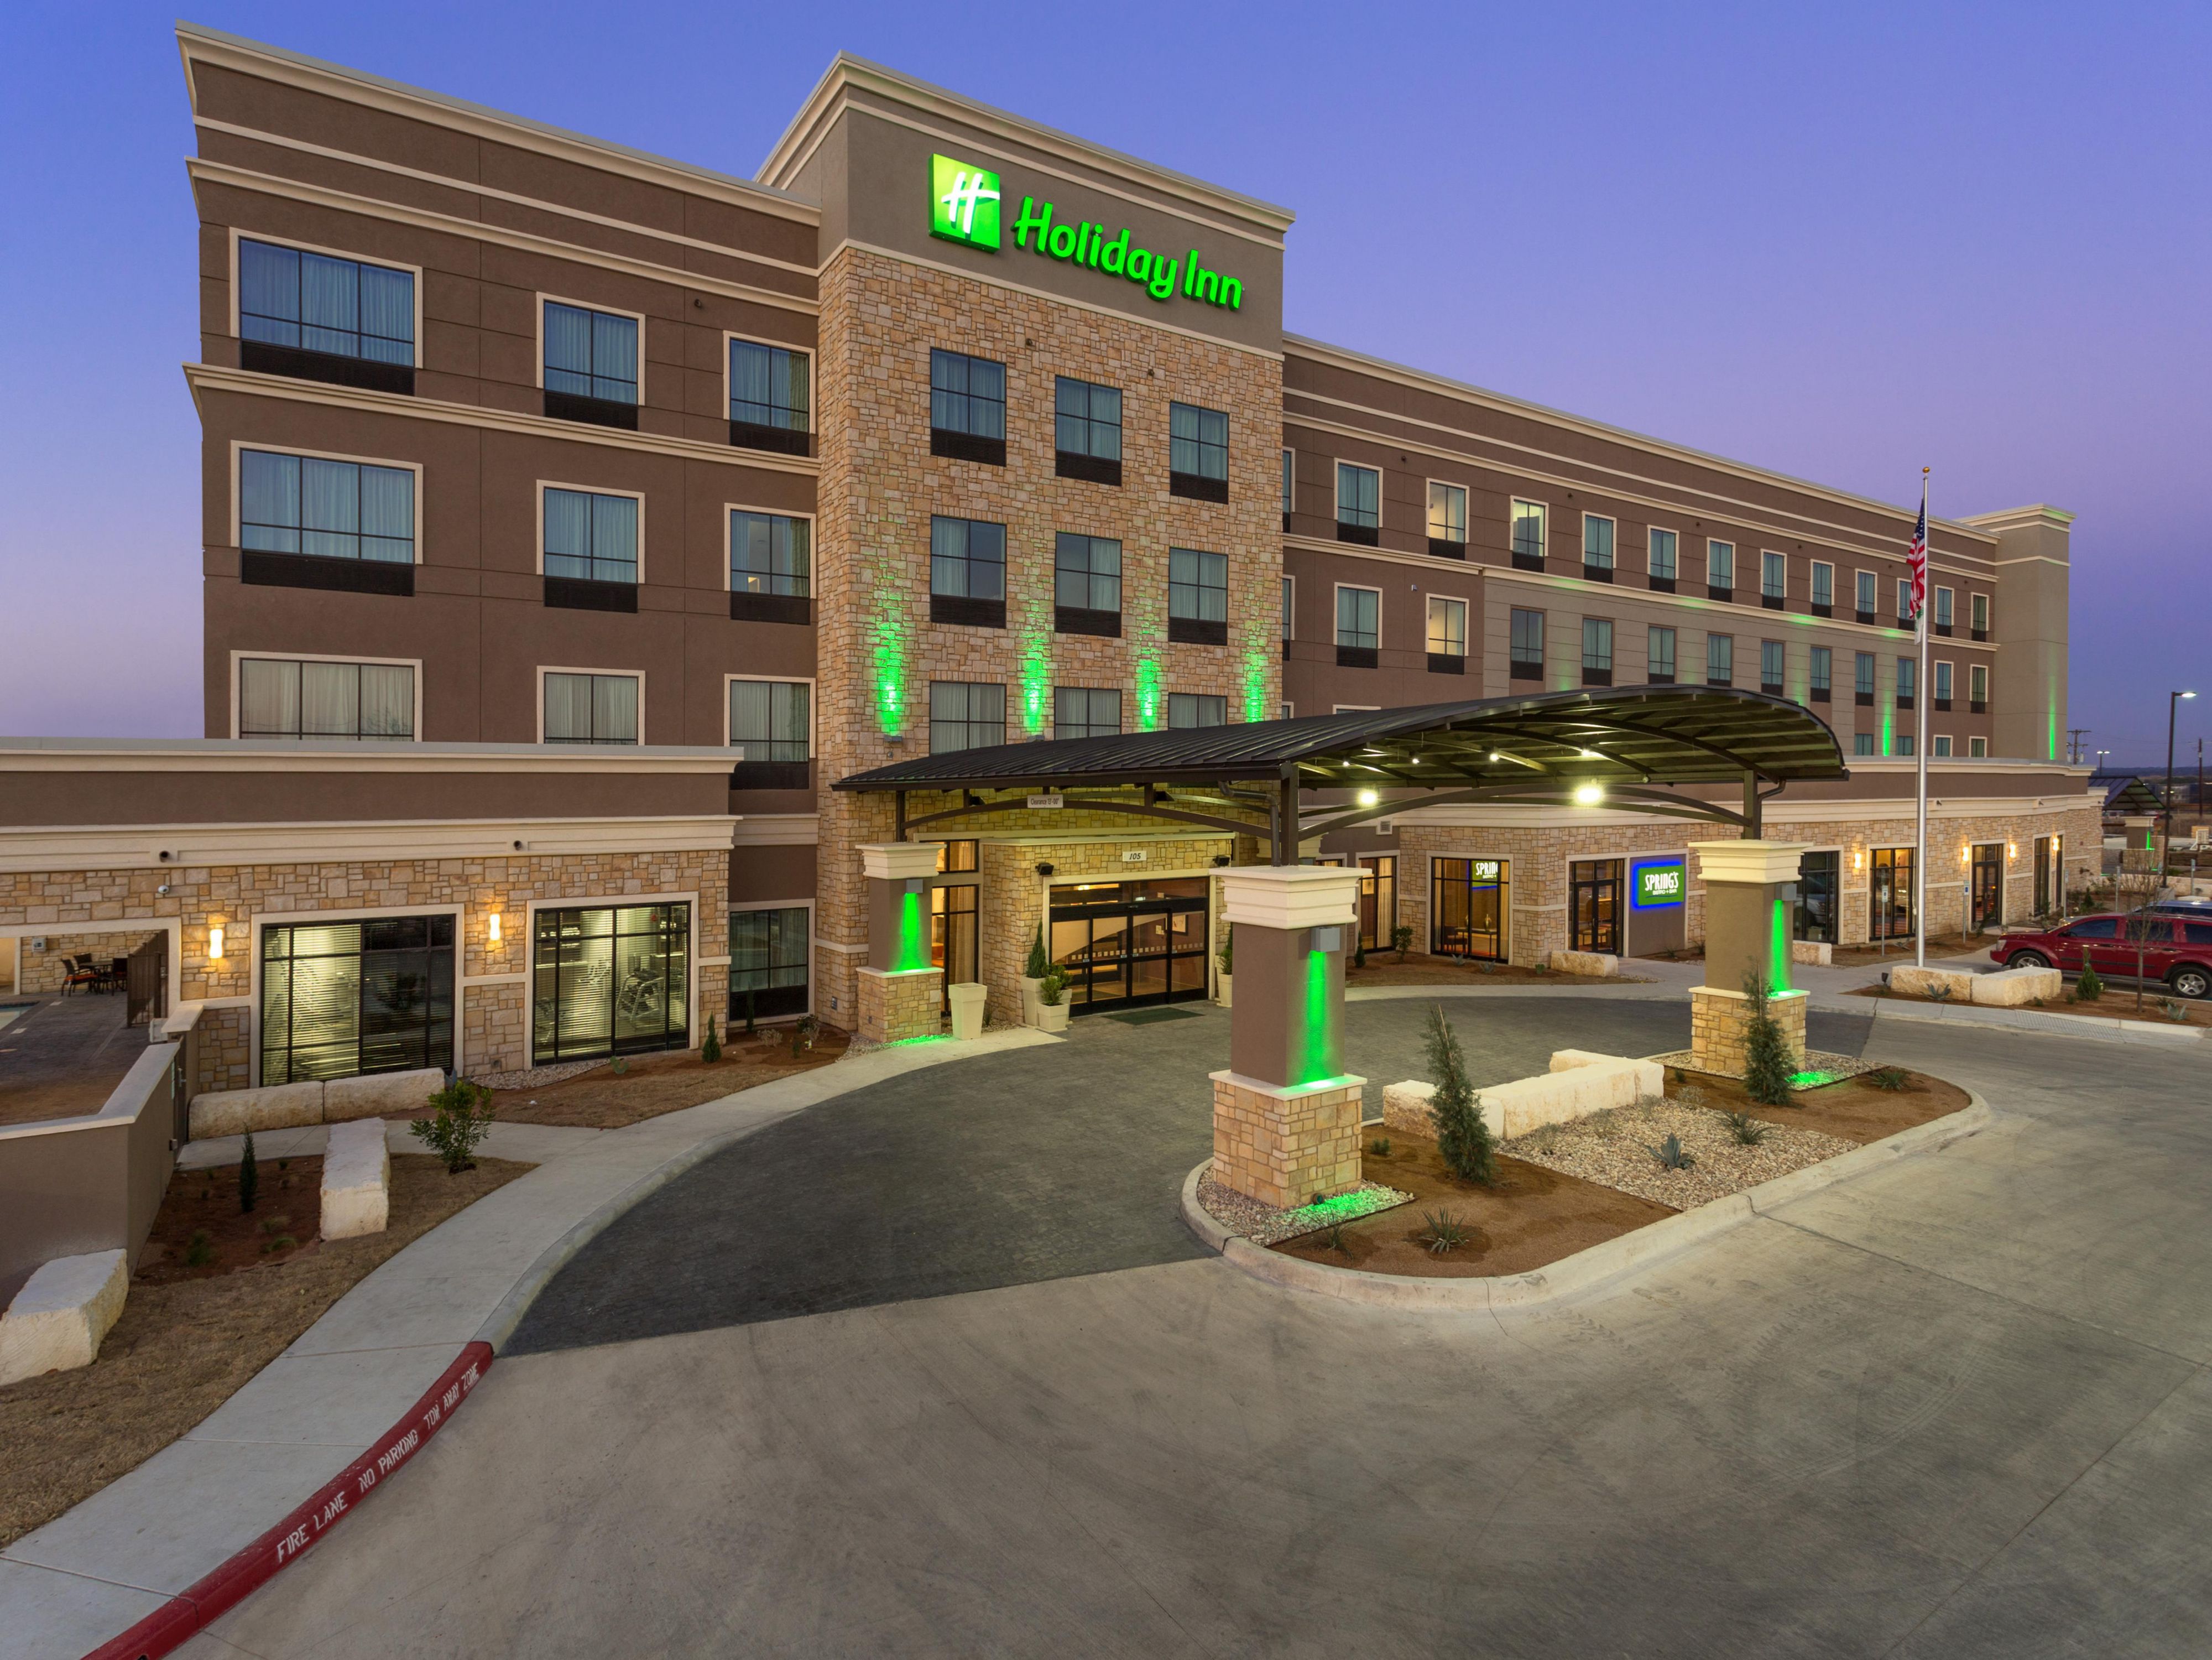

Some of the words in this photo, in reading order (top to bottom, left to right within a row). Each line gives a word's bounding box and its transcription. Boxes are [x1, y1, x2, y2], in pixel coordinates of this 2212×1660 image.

[1013, 196, 1178, 301] Holiday
[1181, 249, 1243, 310] Inn
[277, 1523, 309, 1563] FIRE
[314, 1491, 348, 1530] LANE
[358, 1469, 375, 1492] NO
[378, 1429, 418, 1475] PARKING
[423, 1405, 440, 1429] TOW
[444, 1382, 460, 1411] AWAY
[461, 1362, 479, 1391] ZONE
